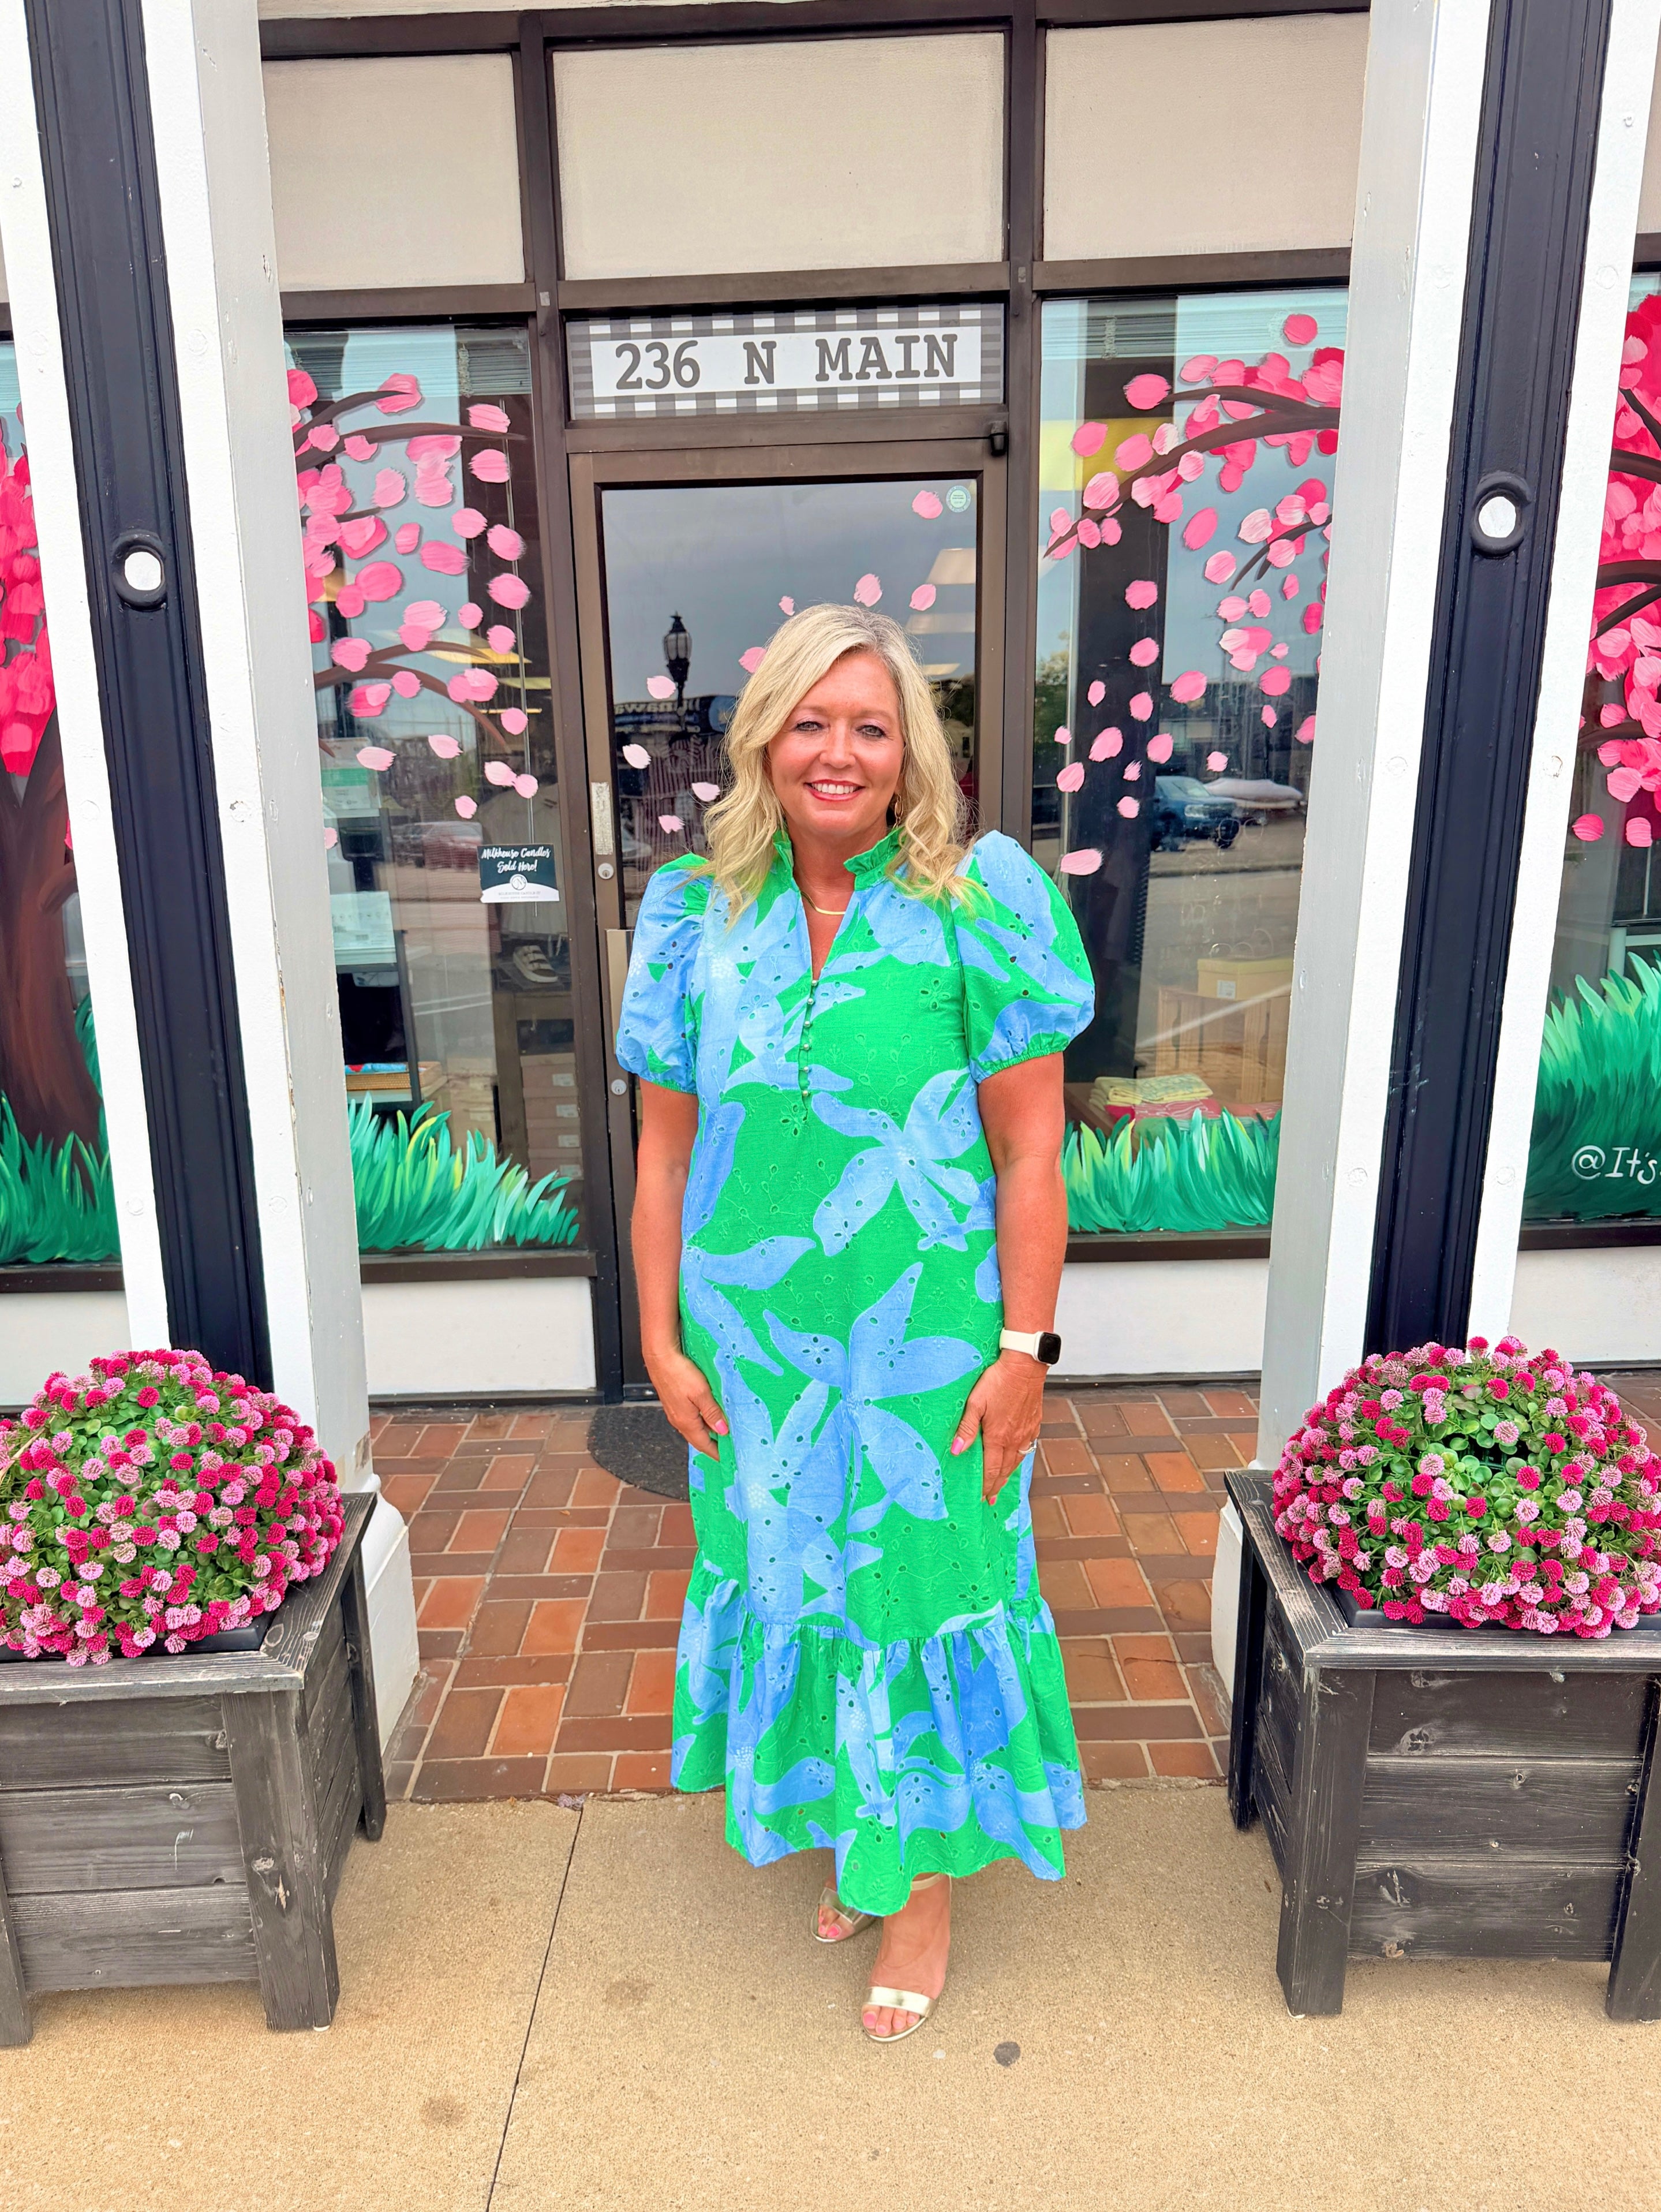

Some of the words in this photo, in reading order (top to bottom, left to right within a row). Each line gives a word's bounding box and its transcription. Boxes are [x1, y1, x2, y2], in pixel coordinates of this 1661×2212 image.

[615, 339, 701, 390] 236
[743, 341, 777, 385] N
[815, 333, 958, 382] MAIN
[481, 847, 519, 860] Milkhouse
[521, 846, 551, 858] Candles
[497, 860, 517, 873] Sold
[518, 859, 538, 872] Here!
[1572, 1145, 1661, 1185] @It's
